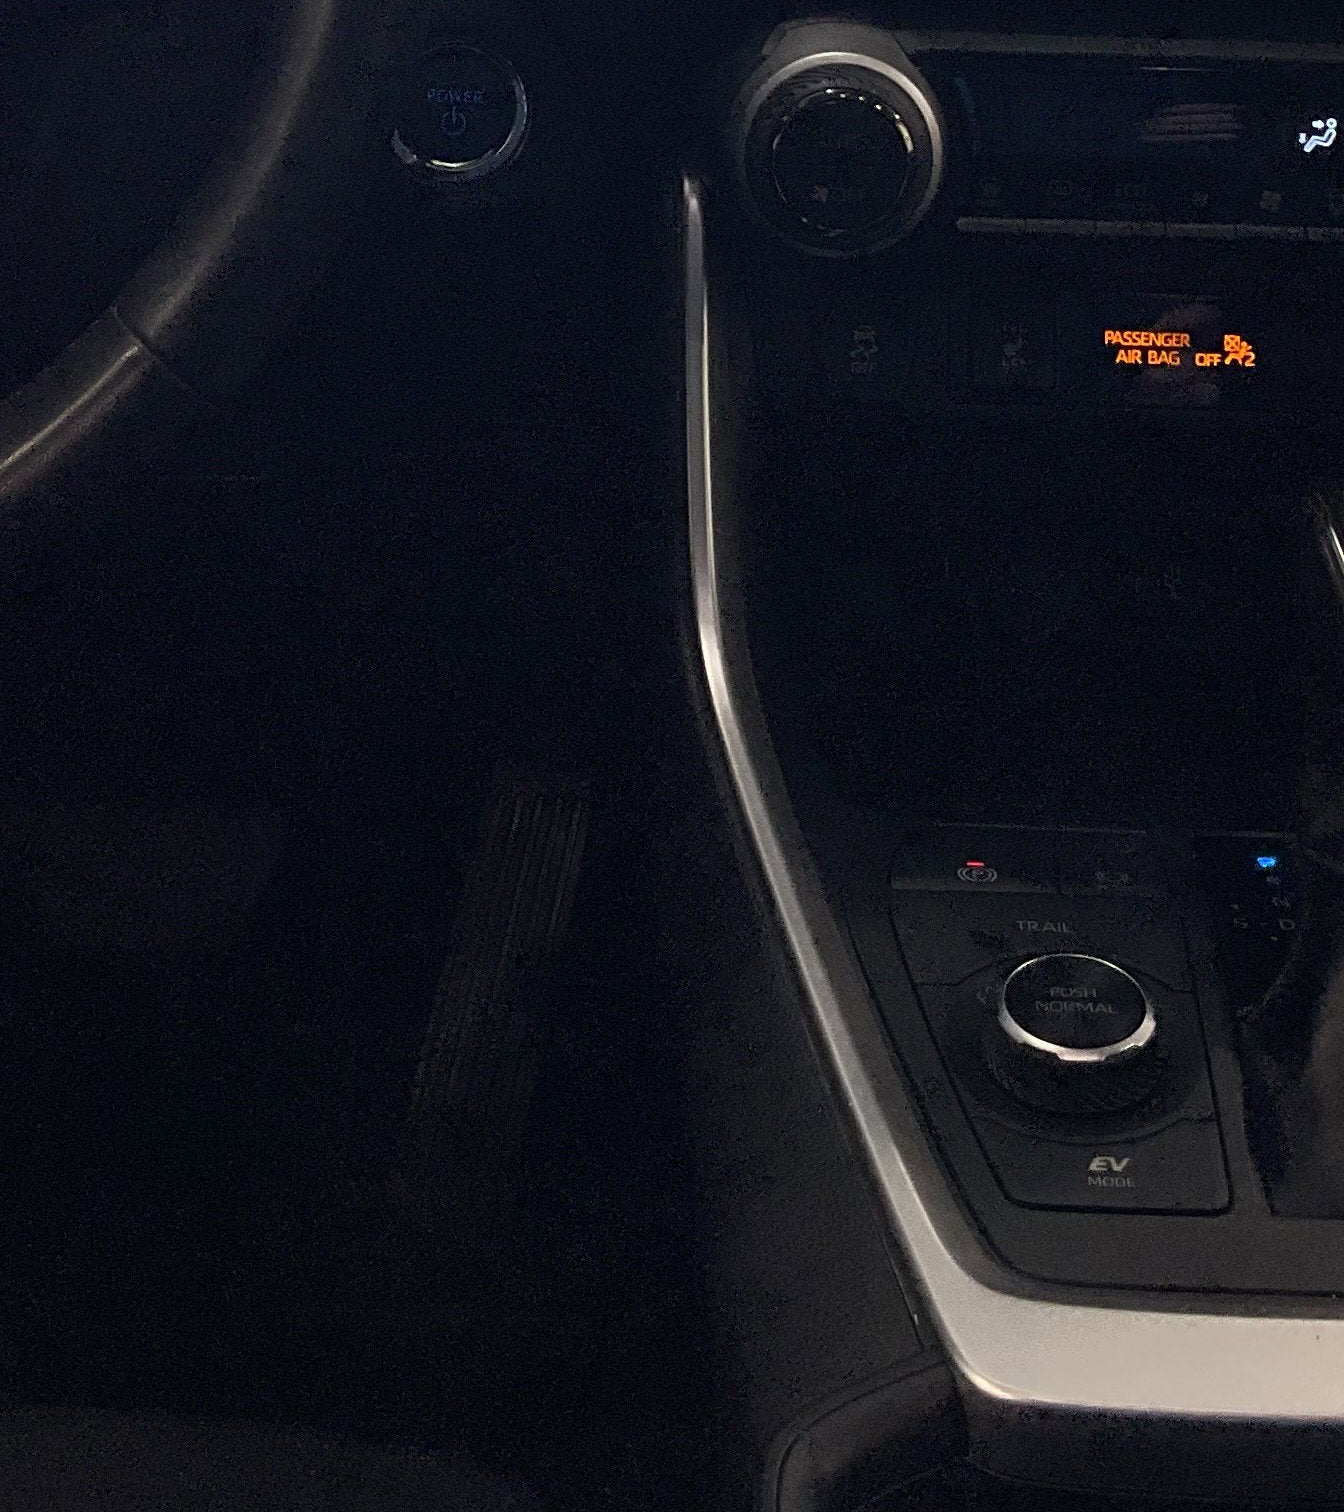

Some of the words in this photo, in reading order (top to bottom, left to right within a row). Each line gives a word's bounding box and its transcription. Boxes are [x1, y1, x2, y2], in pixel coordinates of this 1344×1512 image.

[1104, 330, 1191, 348] PASSENGER
[1115, 349, 1142, 364] AIR
[1147, 350, 1181, 366] BAG
[1194, 353, 1222, 367] OFF
[1016, 919, 1070, 934] TRAIL
[1049, 986, 1098, 999] PUSH
[1034, 999, 1117, 1015] NORMAL
[1088, 1155, 1131, 1173] EV
[1087, 1176, 1134, 1188] MODE
